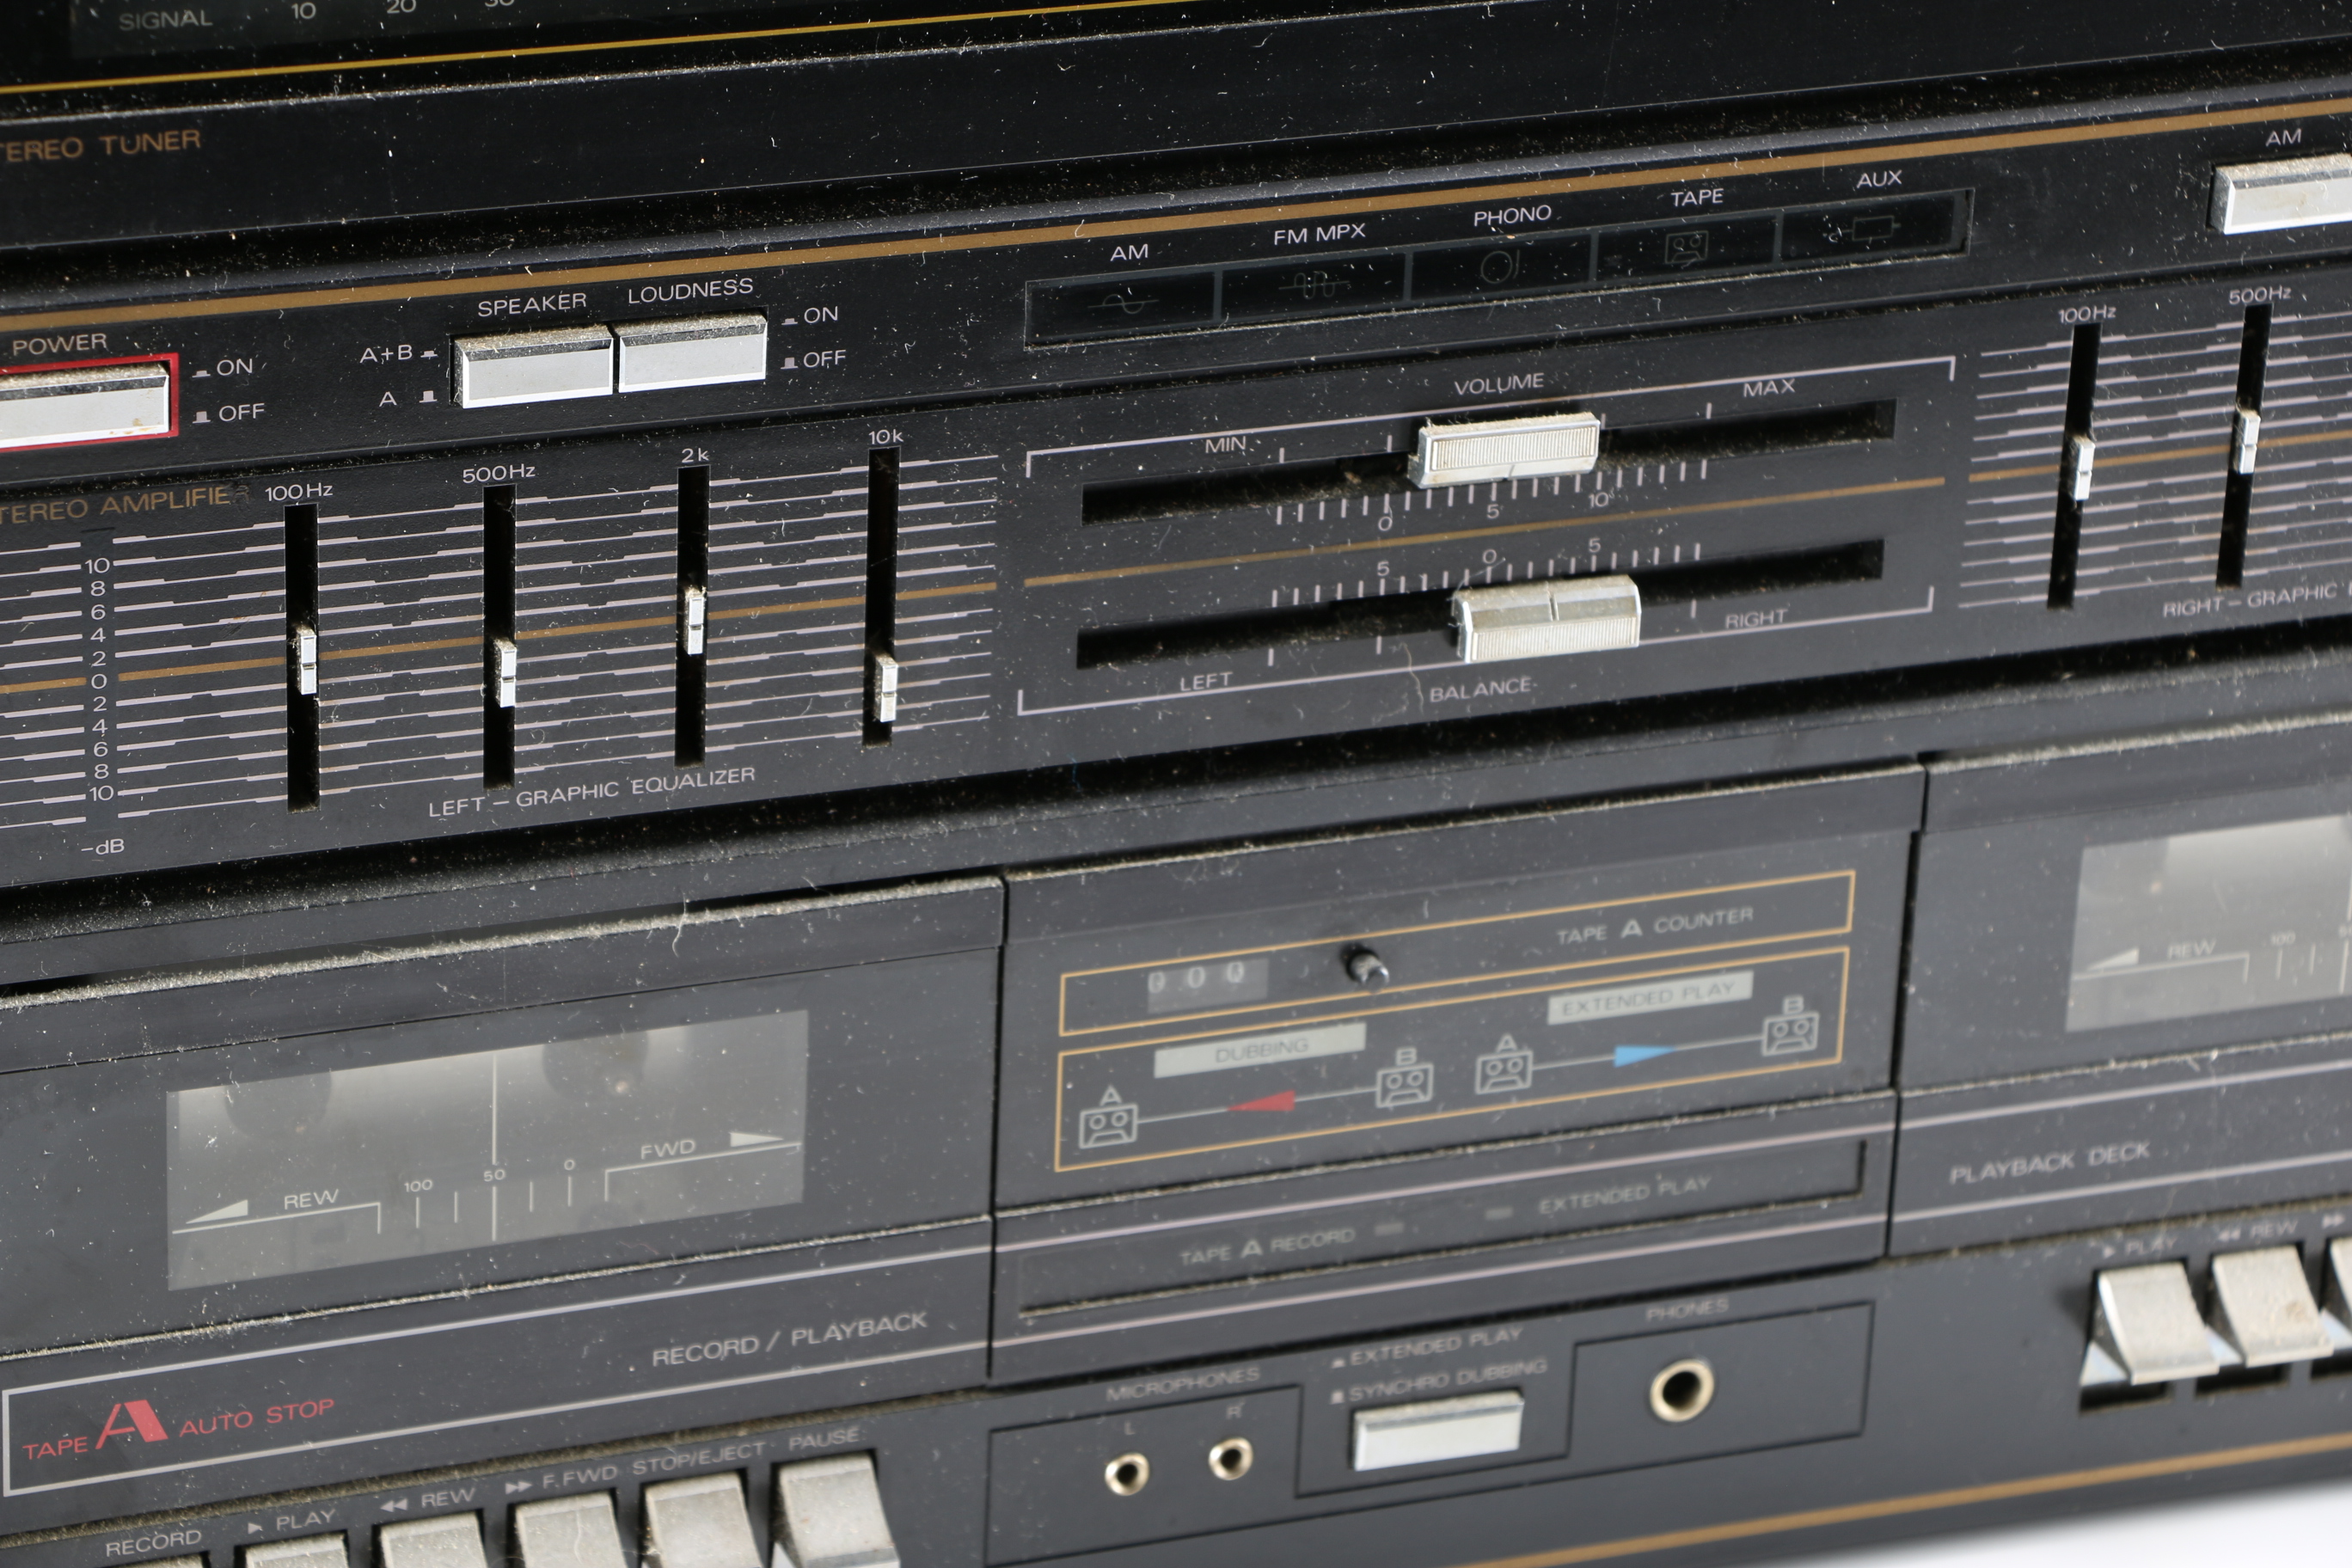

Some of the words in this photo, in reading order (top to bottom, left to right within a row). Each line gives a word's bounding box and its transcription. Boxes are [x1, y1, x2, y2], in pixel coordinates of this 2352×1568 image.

[293, 2, 316, 20] 10
[387, 0, 417, 14] 20
[119, 10, 213, 31] SIGNAL
[99, 129, 201, 155] TUNER
[2265, 128, 2301, 146] AM
[1857, 170, 1902, 188] AUX
[1671, 188, 1724, 207] TAPE
[1473, 205, 1552, 227] PHONO
[1274, 228, 1308, 245] FM
[1315, 223, 1366, 242] MPX
[1111, 244, 1148, 261] AM
[628, 279, 754, 305] LOUDNESS
[2228, 285, 2292, 304] 500Hz
[478, 292, 587, 316] SPEAKER
[2058, 303, 2116, 322] 100Hz
[803, 305, 838, 325] ON
[13, 333, 107, 355] POWER
[359, 345, 413, 364] A+B
[803, 350, 847, 368] OFF
[217, 358, 253, 376] ON
[1455, 372, 1544, 395] VOLUME
[1743, 378, 1796, 397] MAX
[378, 391, 398, 407] A
[218, 402, 265, 422] OFF
[1205, 436, 1246, 455] MIN
[462, 462, 536, 484] 500Hz
[100, 484, 250, 515] AMPLIFIER
[266, 482, 334, 502] 100Hz
[1589, 492, 1609, 507] 10
[1487, 504, 1499, 519] 5
[1378, 516, 1393, 531] 0
[1589, 537, 1601, 554] 5
[85, 558, 110, 573] 10
[1483, 548, 1497, 565] 0
[1377, 561, 1390, 577] 5
[90, 580, 106, 597] 8
[2163, 596, 2225, 617] RIGHT
[2247, 582, 2337, 608] GRAPHIC
[90, 604, 106, 620] 6
[1725, 609, 1788, 629] RIGHT
[90, 627, 106, 643] 4
[91, 651, 107, 667] 2
[91, 673, 107, 689] 0
[1180, 671, 1233, 692] LEFT
[1430, 675, 1532, 702] BALANCE
[93, 696, 107, 712] 2
[92, 719, 108, 734] 4
[93, 742, 108, 757] 6
[94, 763, 109, 779] 8
[89, 785, 114, 801] 10
[430, 796, 486, 818] LEFT
[516, 782, 619, 808] GRAPHIC
[632, 767, 756, 795] EQUALIZER
[1557, 926, 1608, 945] TAPE
[1621, 919, 1643, 938] A
[1654, 907, 1754, 933] COUNTER
[1562, 989, 1674, 1016] EXTENDED
[1682, 981, 1736, 1000] PLAY
[1783, 995, 1804, 1014] B
[1216, 1038, 1308, 1063] DUBBING
[1496, 1034, 1517, 1053] A
[1396, 1048, 1418, 1066] B
[1100, 1085, 1122, 1106] A
[640, 1139, 695, 1160] FWD
[1951, 1150, 2074, 1185] PLAYBACK
[2088, 1141, 2149, 1167] DECK
[483, 1169, 505, 1182] 50
[403, 1179, 433, 1193] 100
[1540, 1184, 1651, 1215] EXTENDED
[1657, 1177, 1712, 1196] PLAY
[284, 1188, 339, 1210] REW
[1180, 1245, 1231, 1265] TAPE
[1240, 1240, 1263, 1259] A
[1271, 1228, 1356, 1253] RECORD
[1646, 1298, 1729, 1323] PHONES
[652, 1336, 759, 1367] RECORD
[792, 1311, 928, 1346] PLAYBACK
[1351, 1337, 1461, 1368] EXTENDED
[1469, 1326, 1524, 1347] PLAY
[1106, 1366, 1261, 1402] MICROPHONES
[1350, 1372, 1450, 1403] SYNCHRO
[1456, 1357, 1547, 1386] DUBBING
[22, 1436, 88, 1461] TAPE
[95, 1400, 168, 1450] A
[179, 1411, 253, 1437] AUTO
[266, 1399, 335, 1424] STOP
[788, 1428, 858, 1452] PAUSE
[632, 1442, 764, 1476] STOP/EJECT
[420, 1487, 475, 1509] REW
[277, 1510, 335, 1531] PLAY
[106, 1529, 201, 1559] RECORD
